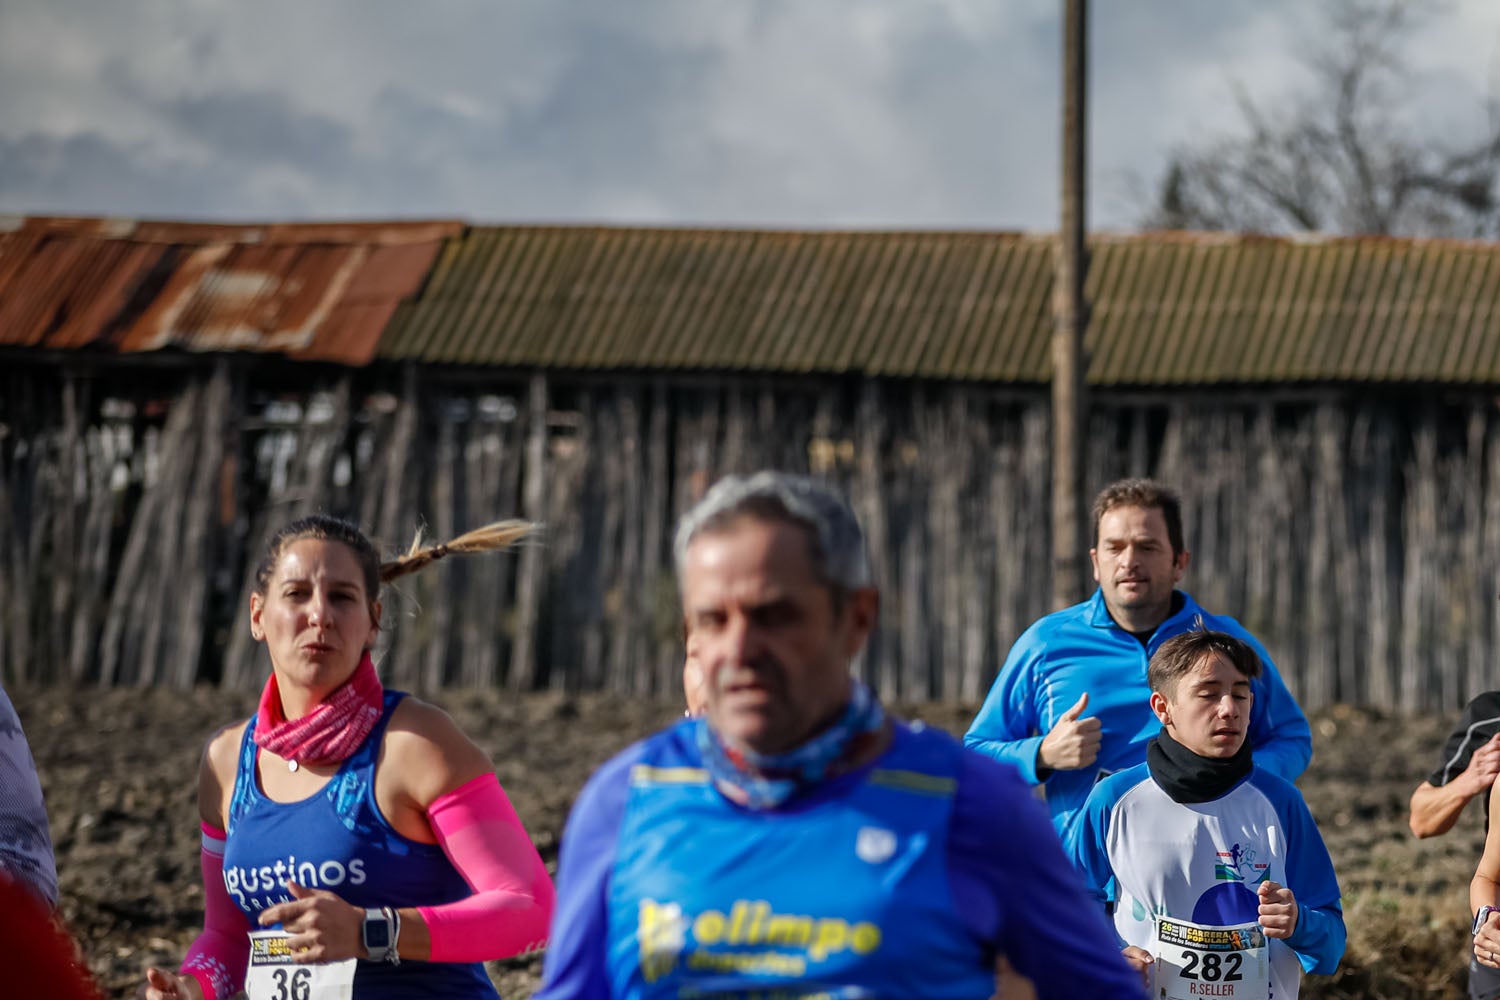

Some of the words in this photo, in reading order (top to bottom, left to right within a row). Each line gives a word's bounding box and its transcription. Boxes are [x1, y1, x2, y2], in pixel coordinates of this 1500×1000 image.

[223, 855, 367, 898] gustinos
[1161, 922, 1172, 932] 26
[1187, 927, 1229, 939] CARRERA
[1187, 934, 1229, 944] POPULAR
[1180, 951, 1243, 982] 282
[1190, 983, 1234, 996] R.SELLER
